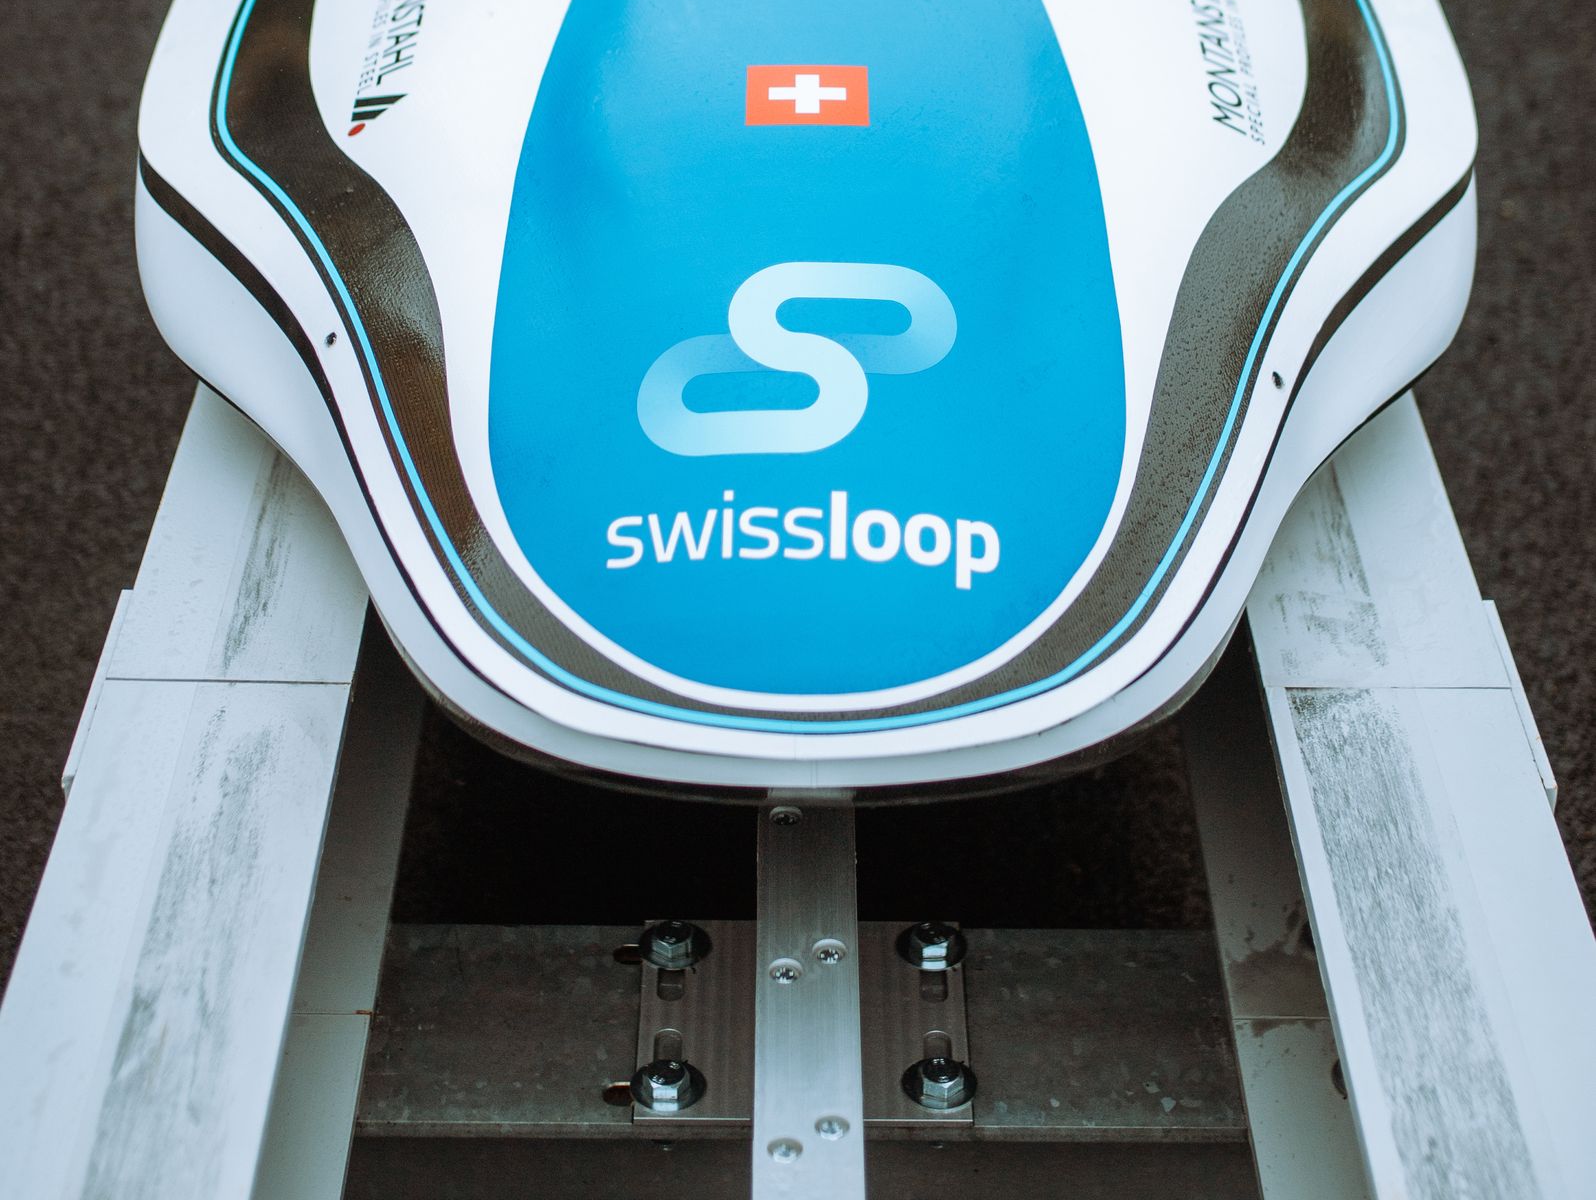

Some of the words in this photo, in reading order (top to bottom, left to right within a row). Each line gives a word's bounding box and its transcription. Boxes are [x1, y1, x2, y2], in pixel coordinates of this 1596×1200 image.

[356, 52, 380, 96] STEEL
[1243, 83, 1266, 146] SPECIAL
[605, 489, 1001, 591] swissloop
